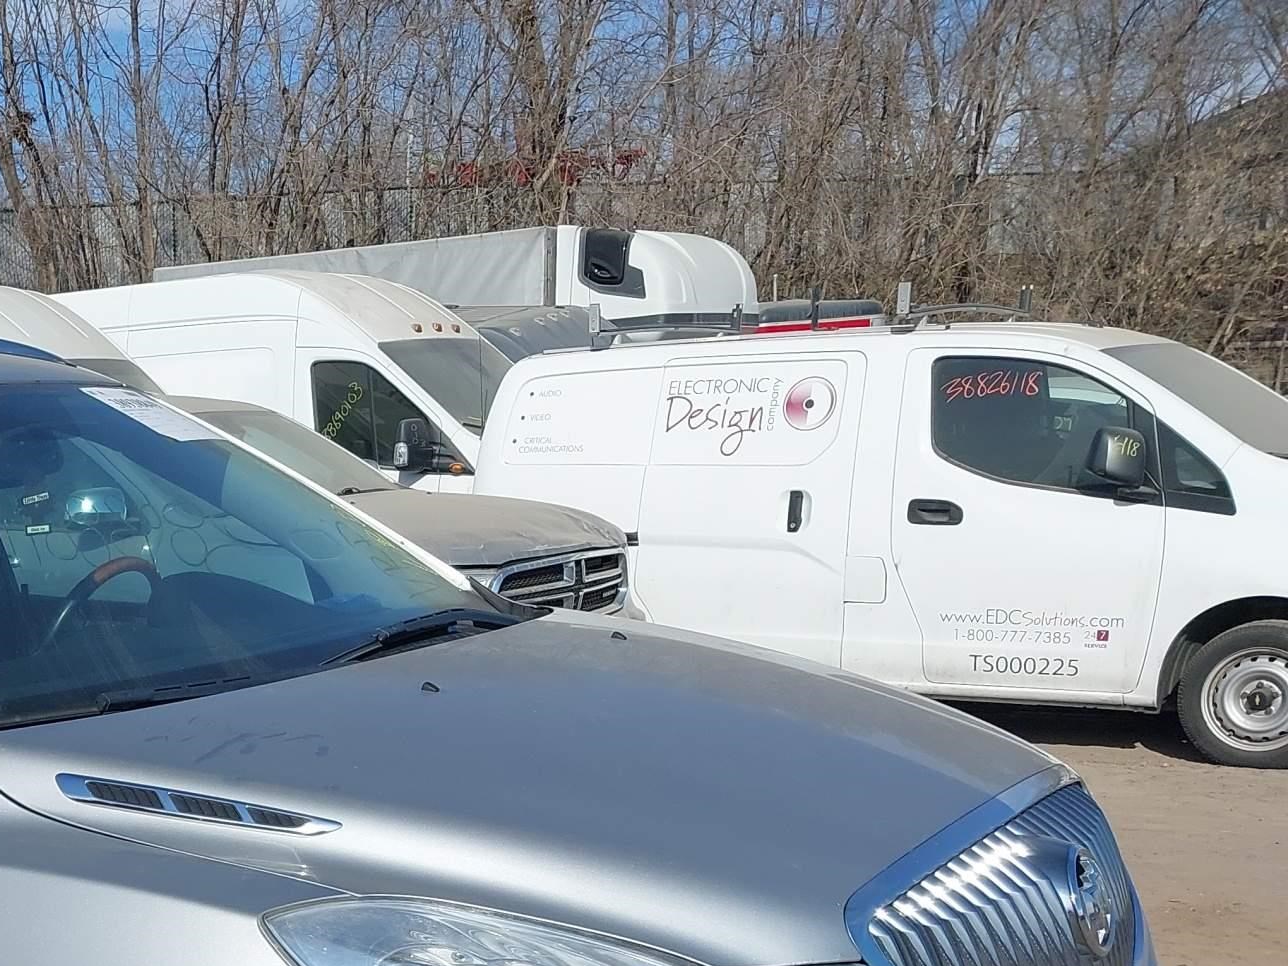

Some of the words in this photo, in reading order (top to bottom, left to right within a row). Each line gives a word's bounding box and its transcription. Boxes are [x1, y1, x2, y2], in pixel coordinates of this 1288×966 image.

[538, 389, 562, 398] AUDIO
[668, 377, 770, 396] ELECTRONIC
[939, 368, 1044, 404] 38826118
[767, 378, 785, 432] company
[530, 413, 552, 422] VIDEO
[665, 396, 764, 456] Design
[518, 444, 584, 454] COMMUNICATIONS
[523, 437, 552, 445] CRITICAL
[939, 609, 1125, 629] www.EDCSolutions.com
[953, 628, 1071, 645] 1-800-777-7385
[969, 655, 1080, 677] TS000225
